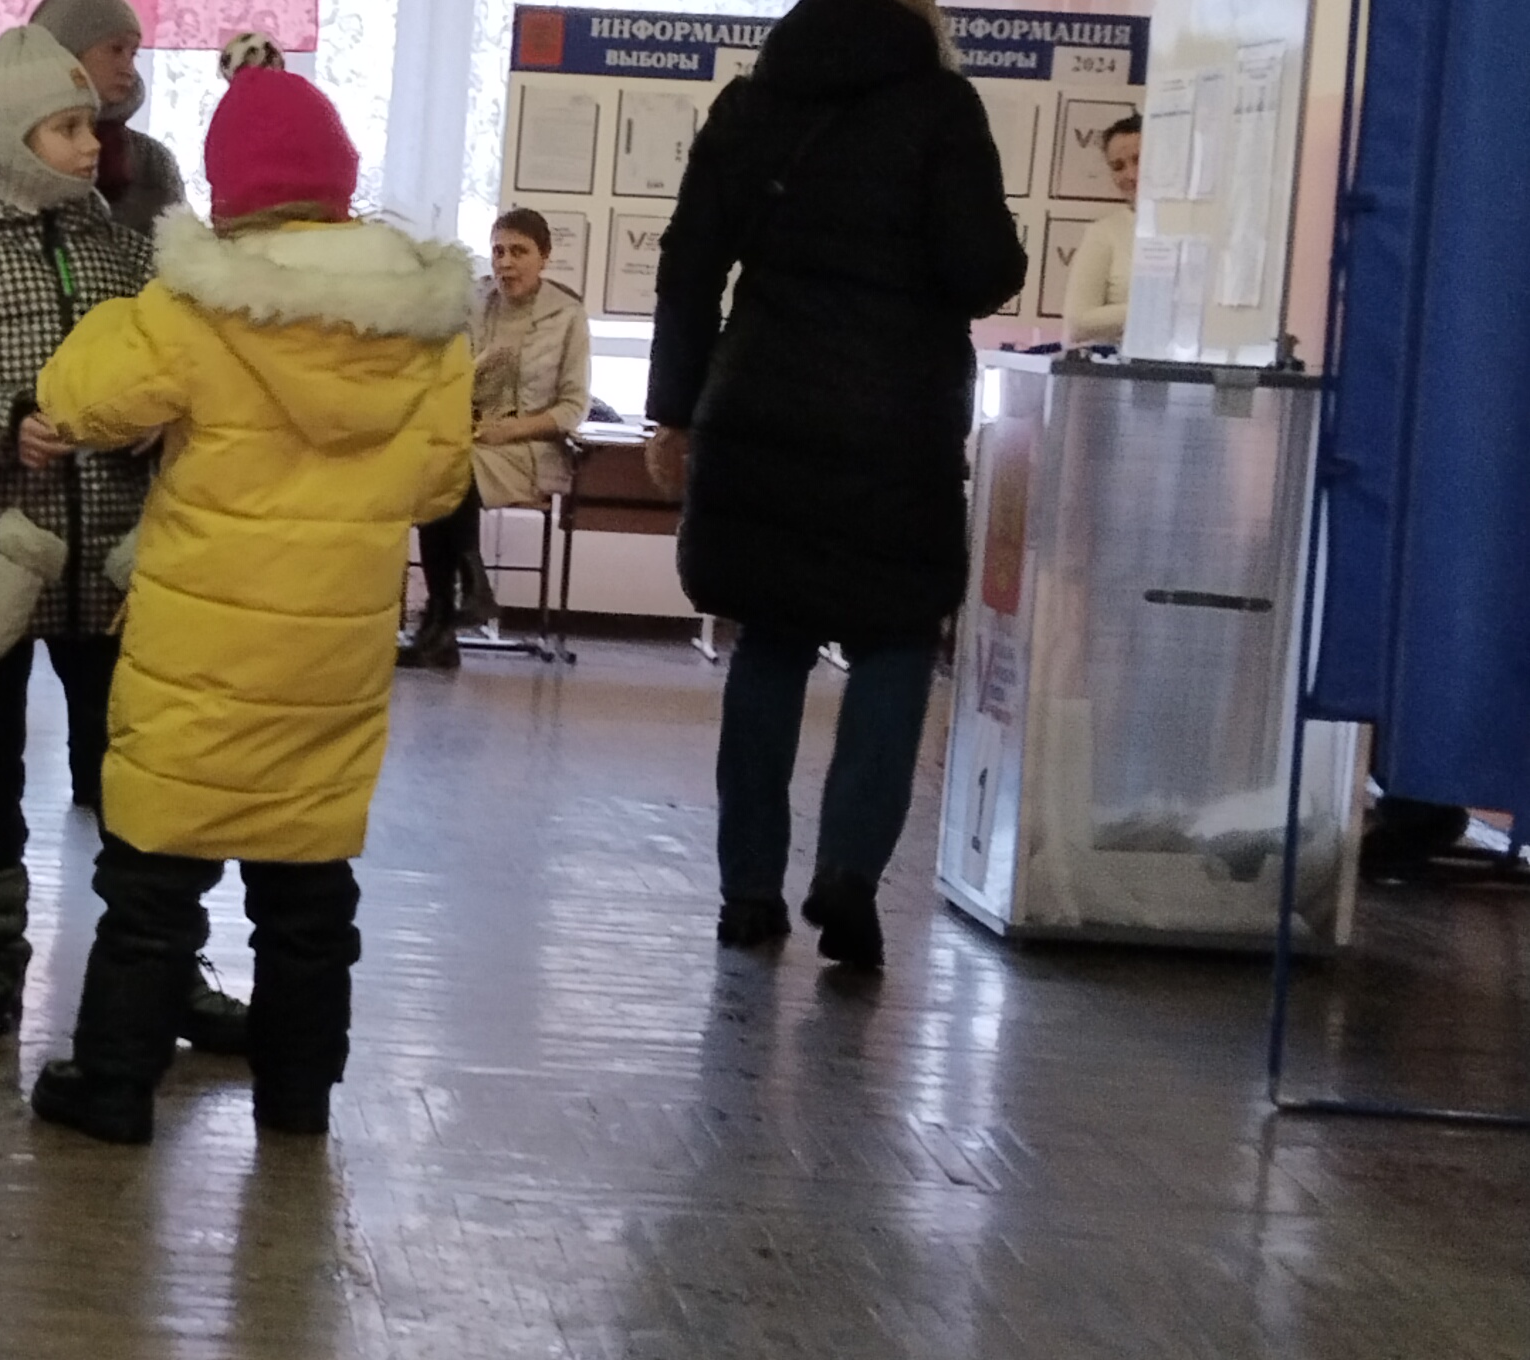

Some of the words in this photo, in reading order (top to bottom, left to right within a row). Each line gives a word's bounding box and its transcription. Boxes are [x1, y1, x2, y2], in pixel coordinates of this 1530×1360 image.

[590, 17, 773, 47] ИНФОРМАЦИ
[946, 16, 1131, 46] НФОРМАЦИЯ
[605, 49, 700, 70] ВЫБОРЫ
[959, 48, 1037, 69] ЫБОРЫ
[1072, 55, 1117, 73] 2024
